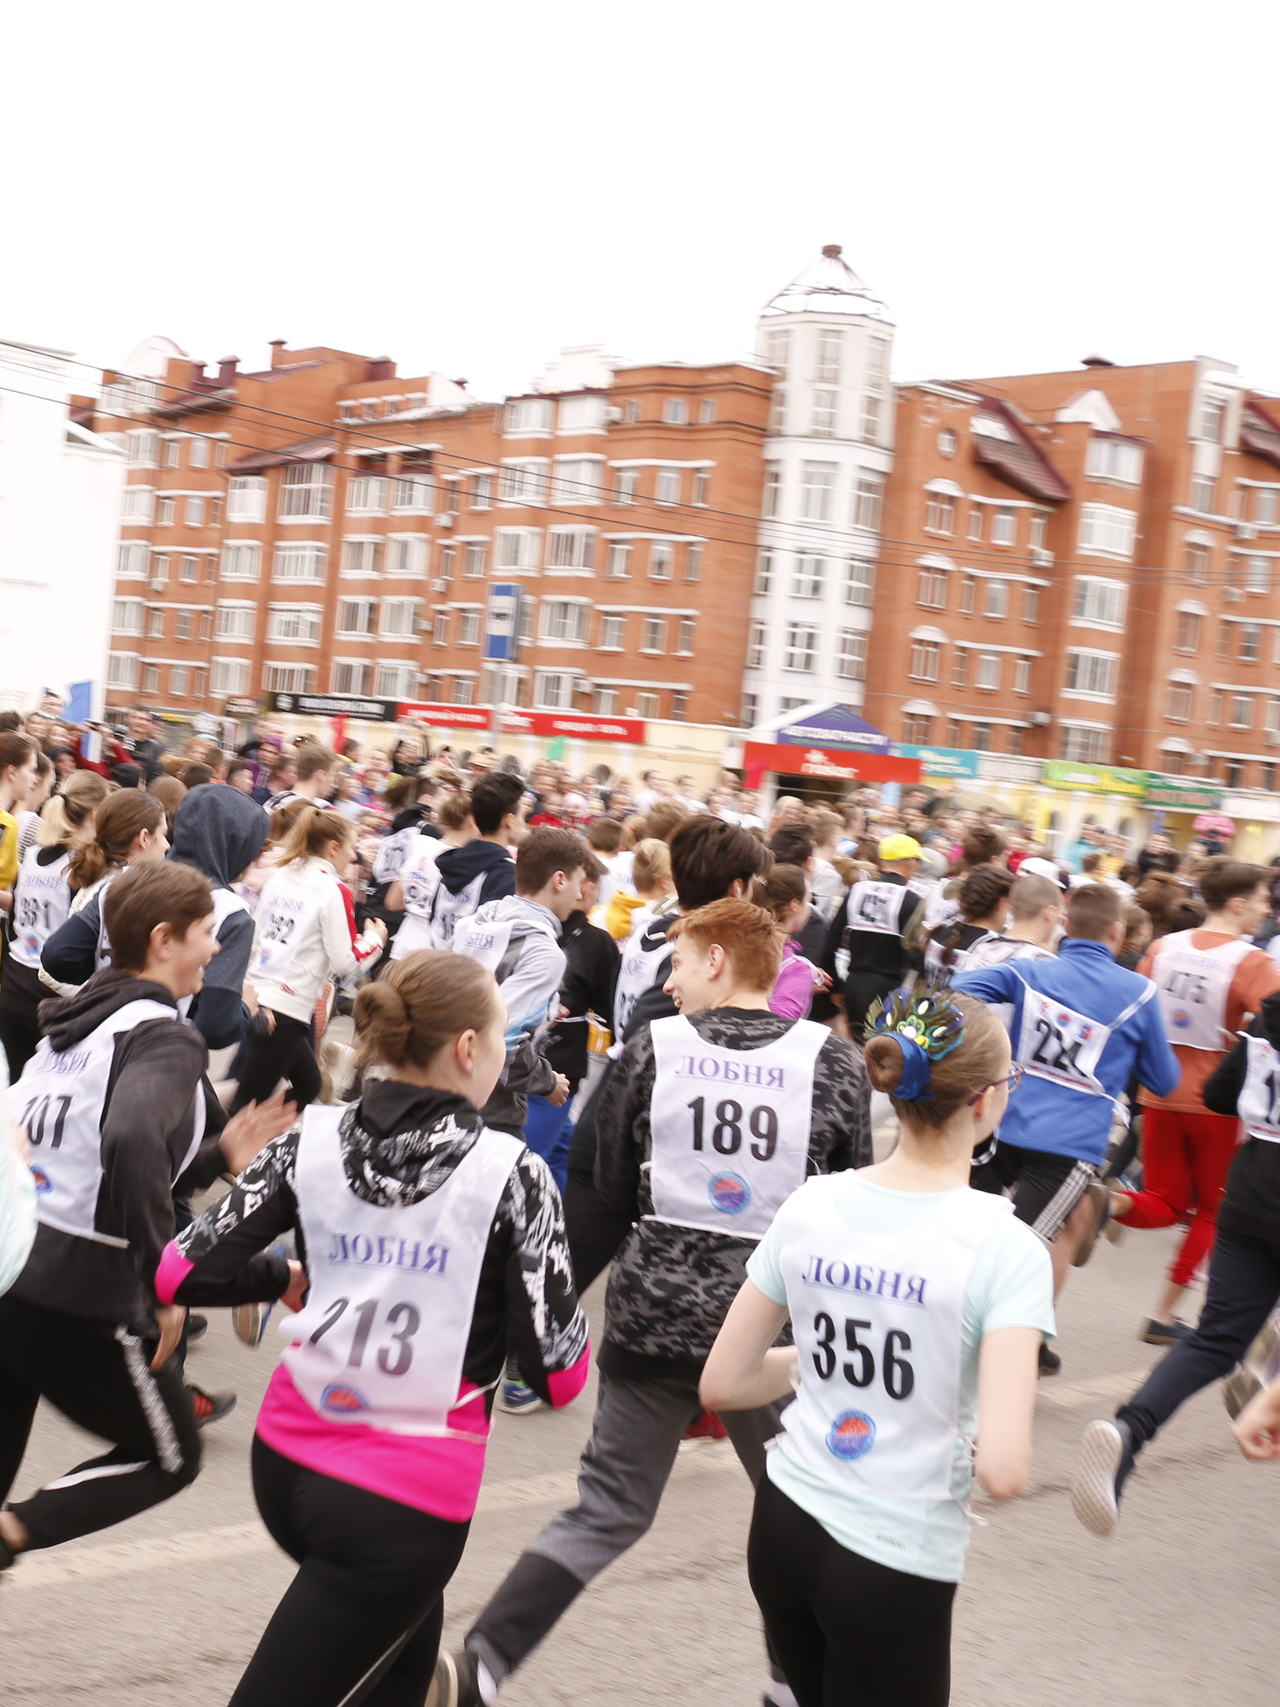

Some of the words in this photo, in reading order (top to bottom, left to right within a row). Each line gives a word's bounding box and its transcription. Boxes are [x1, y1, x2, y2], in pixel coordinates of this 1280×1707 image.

[675, 1055, 786, 1089] ЛОБНЯ
[687, 1095, 778, 1162] 189
[328, 1233, 451, 1274] ЛОБНЯ
[802, 1255, 929, 1305] ЛОБНЯ
[308, 1296, 421, 1376] 213
[812, 1310, 914, 1400] 356
